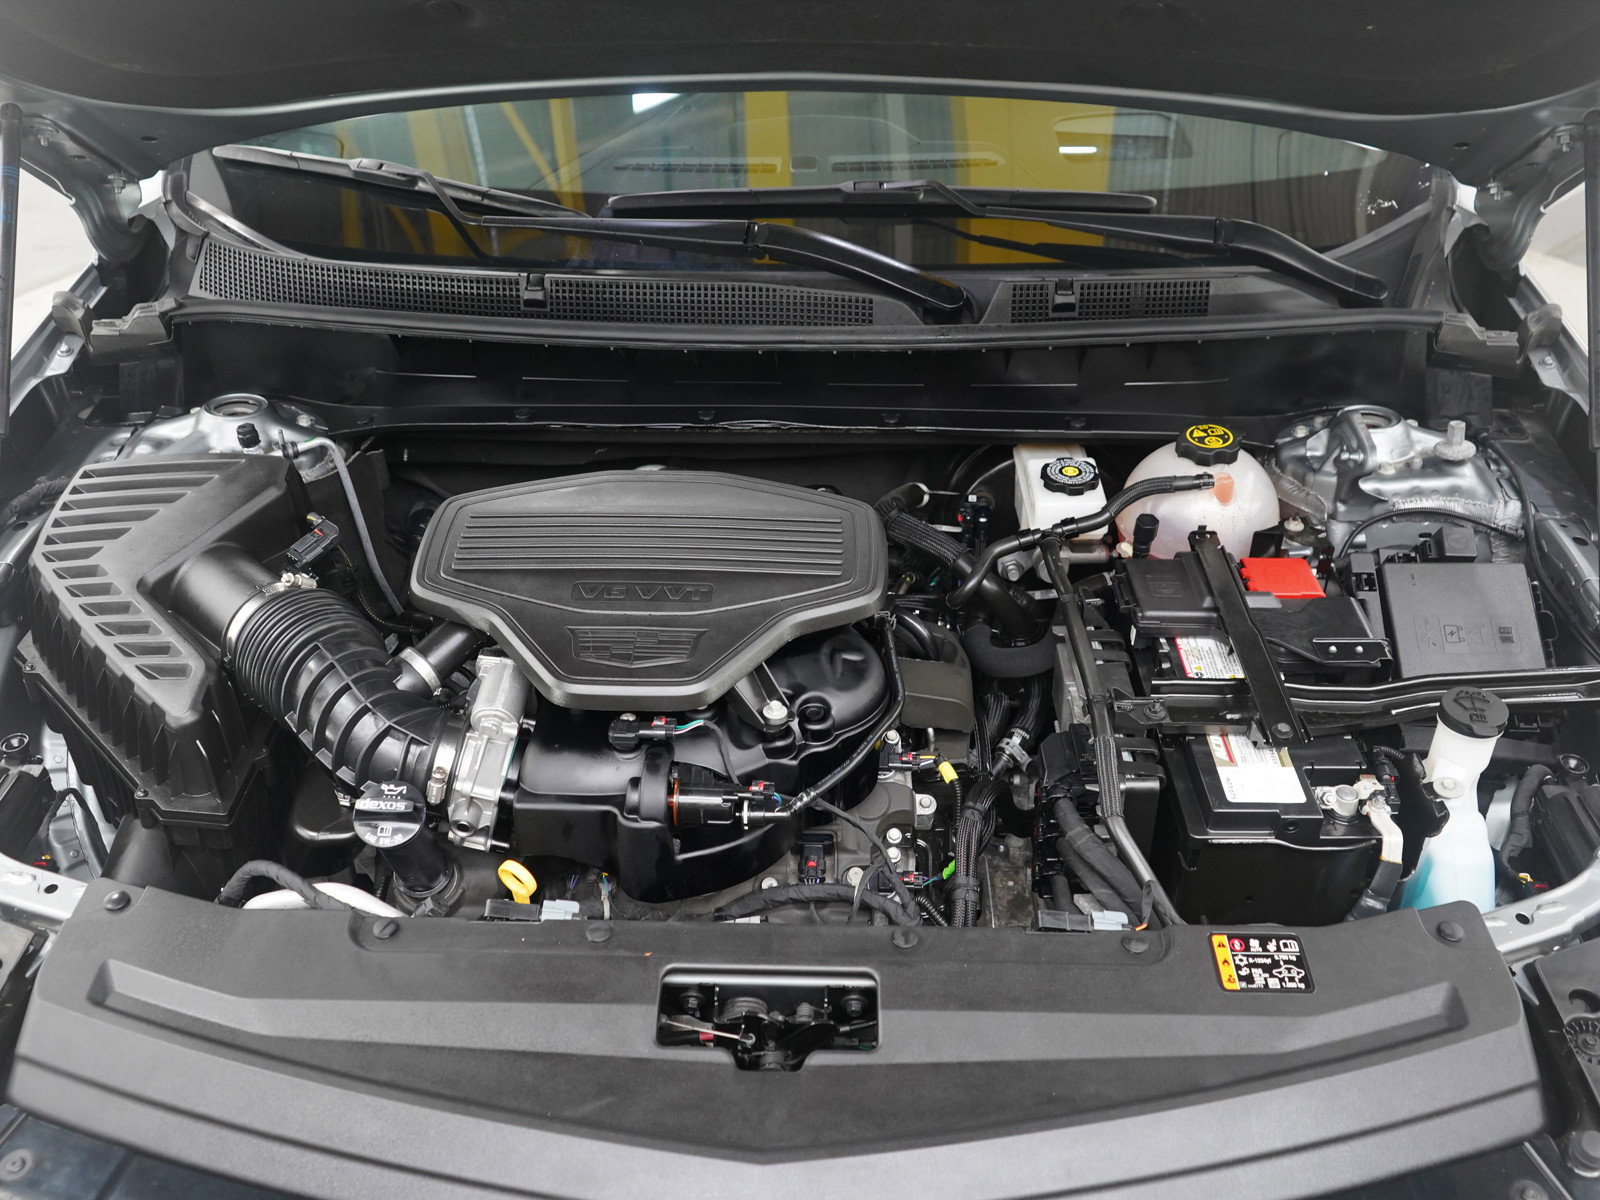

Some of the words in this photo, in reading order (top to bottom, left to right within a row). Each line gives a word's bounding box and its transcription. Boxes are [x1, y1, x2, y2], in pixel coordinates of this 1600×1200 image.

[578, 584, 627, 599] V6
[635, 584, 708, 600] VVT
[360, 798, 407, 810] dexos
